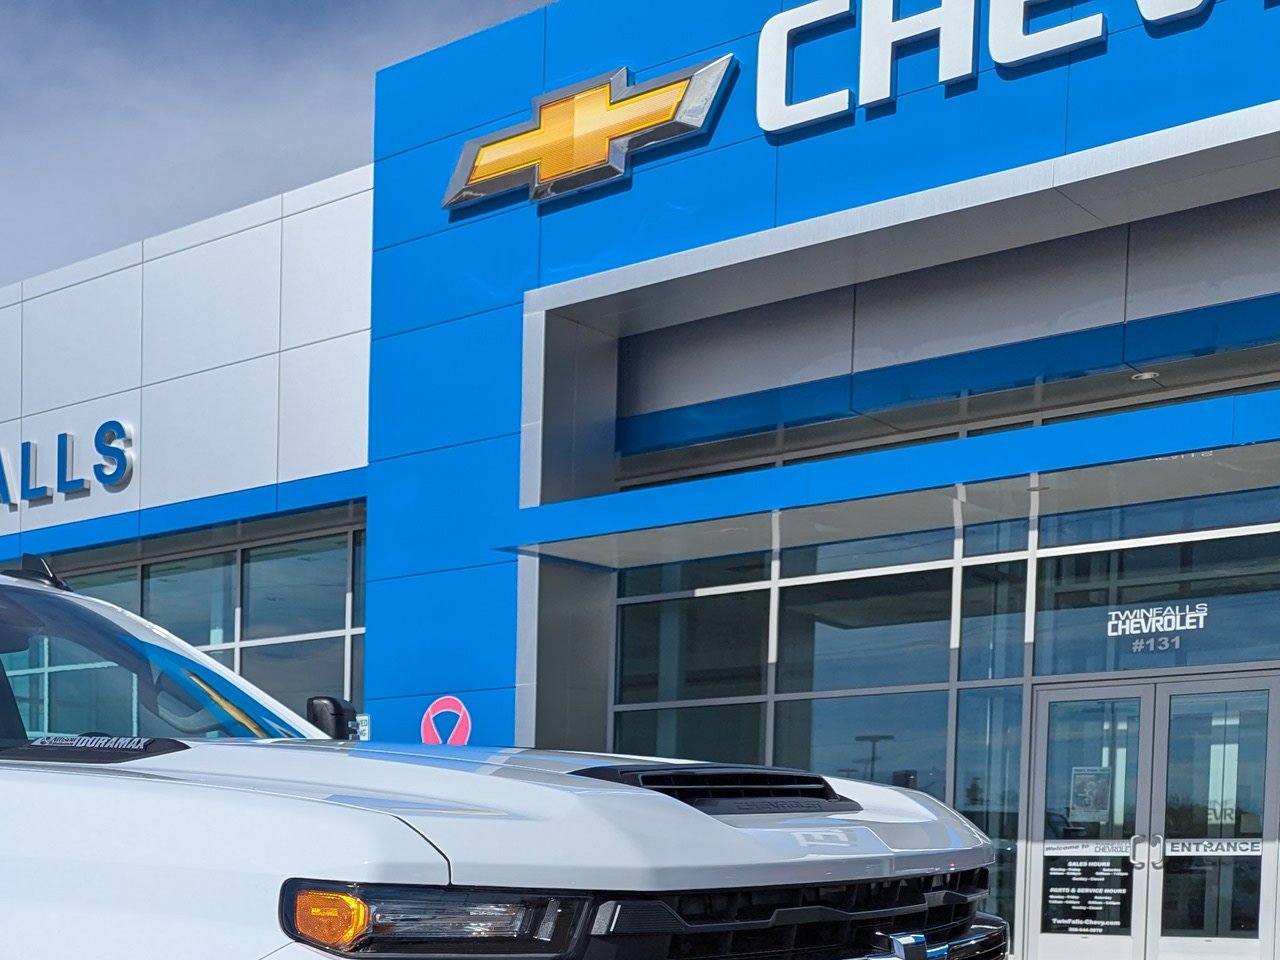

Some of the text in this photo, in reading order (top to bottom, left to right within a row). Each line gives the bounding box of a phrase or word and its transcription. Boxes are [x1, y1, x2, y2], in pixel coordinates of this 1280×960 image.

[756, 0, 1208, 132] CHE
[1108, 603, 1208, 621] TWINFALLS
[1107, 613, 1208, 636] CHEVROLET
[1131, 635, 1181, 653] #131
[75, 736, 149, 750] DURAMAX
[736, 800, 822, 811] CHEVROLET
[1170, 841, 1261, 853] ENTRANCE
